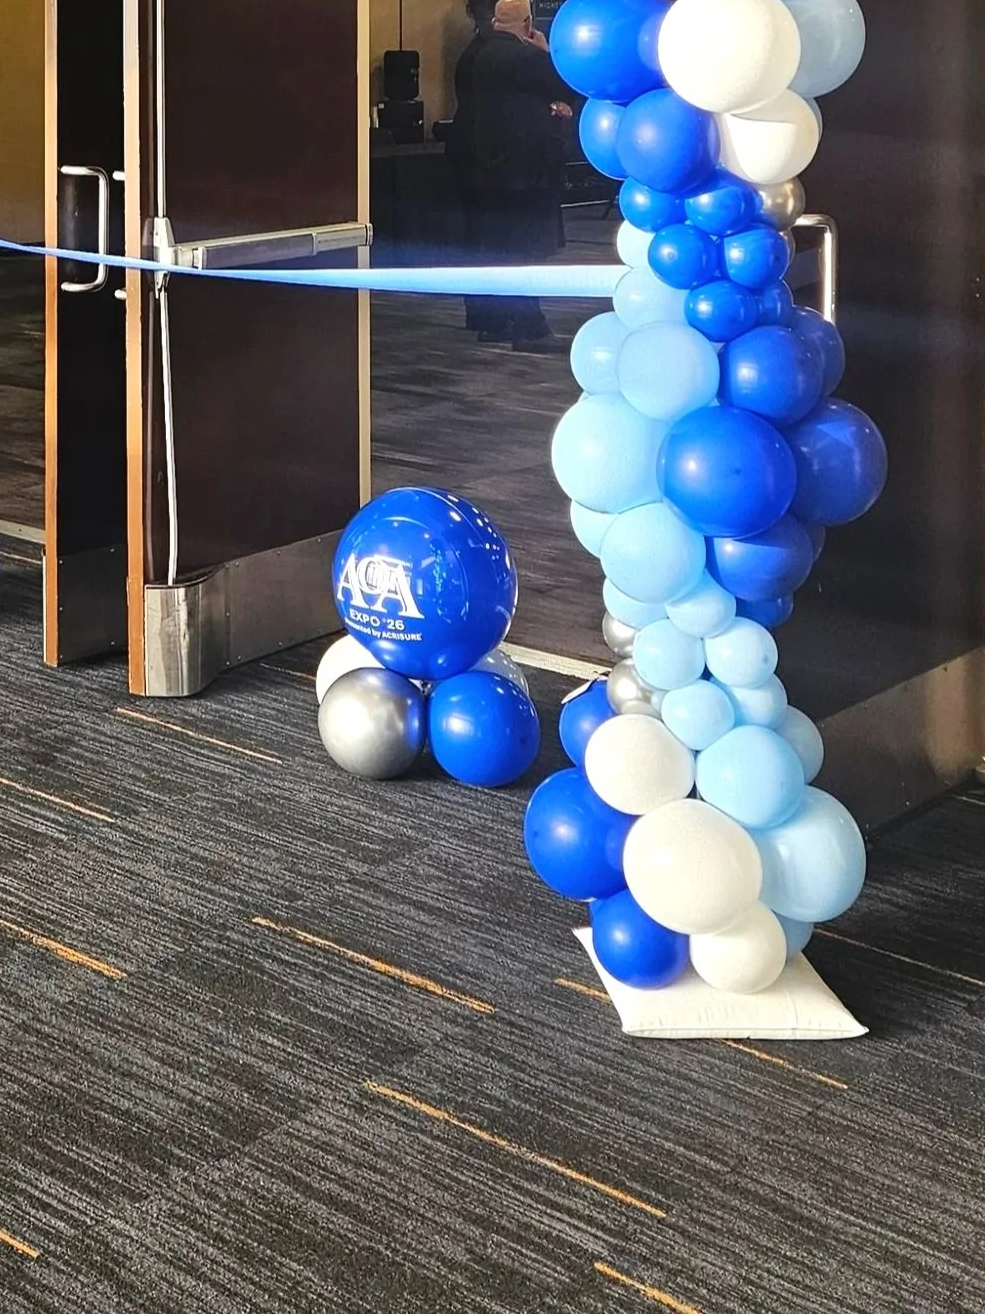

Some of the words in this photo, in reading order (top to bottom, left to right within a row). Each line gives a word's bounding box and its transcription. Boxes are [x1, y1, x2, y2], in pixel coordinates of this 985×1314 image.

[337, 553, 425, 618] AOA
[349, 608, 381, 627] EXPO
[381, 631, 422, 641] ACRISURE
